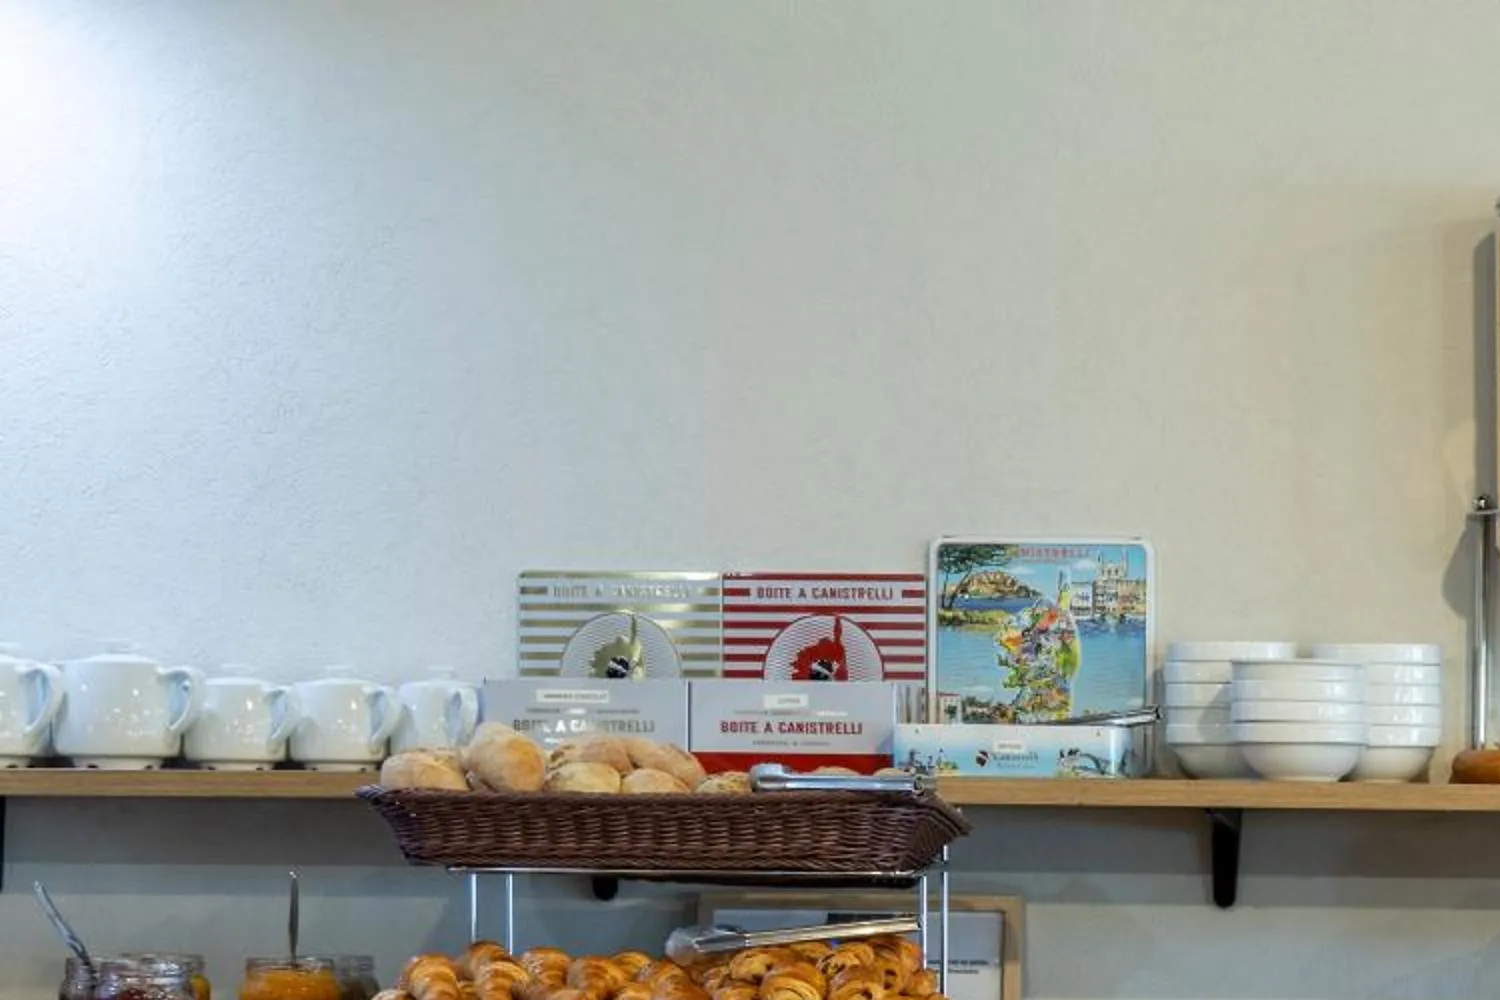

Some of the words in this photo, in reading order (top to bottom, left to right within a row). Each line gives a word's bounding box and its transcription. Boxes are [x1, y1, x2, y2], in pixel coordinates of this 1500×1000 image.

[756, 586, 793, 599] BOITE
[797, 587, 807, 599] A
[811, 587, 893, 600] CANISTRELLI
[555, 719, 567, 733] A
[570, 719, 656, 733] CASTRELLI
[720, 720, 757, 734] BOITE
[763, 721, 774, 734] A
[777, 720, 864, 736] CANISTRELLI
